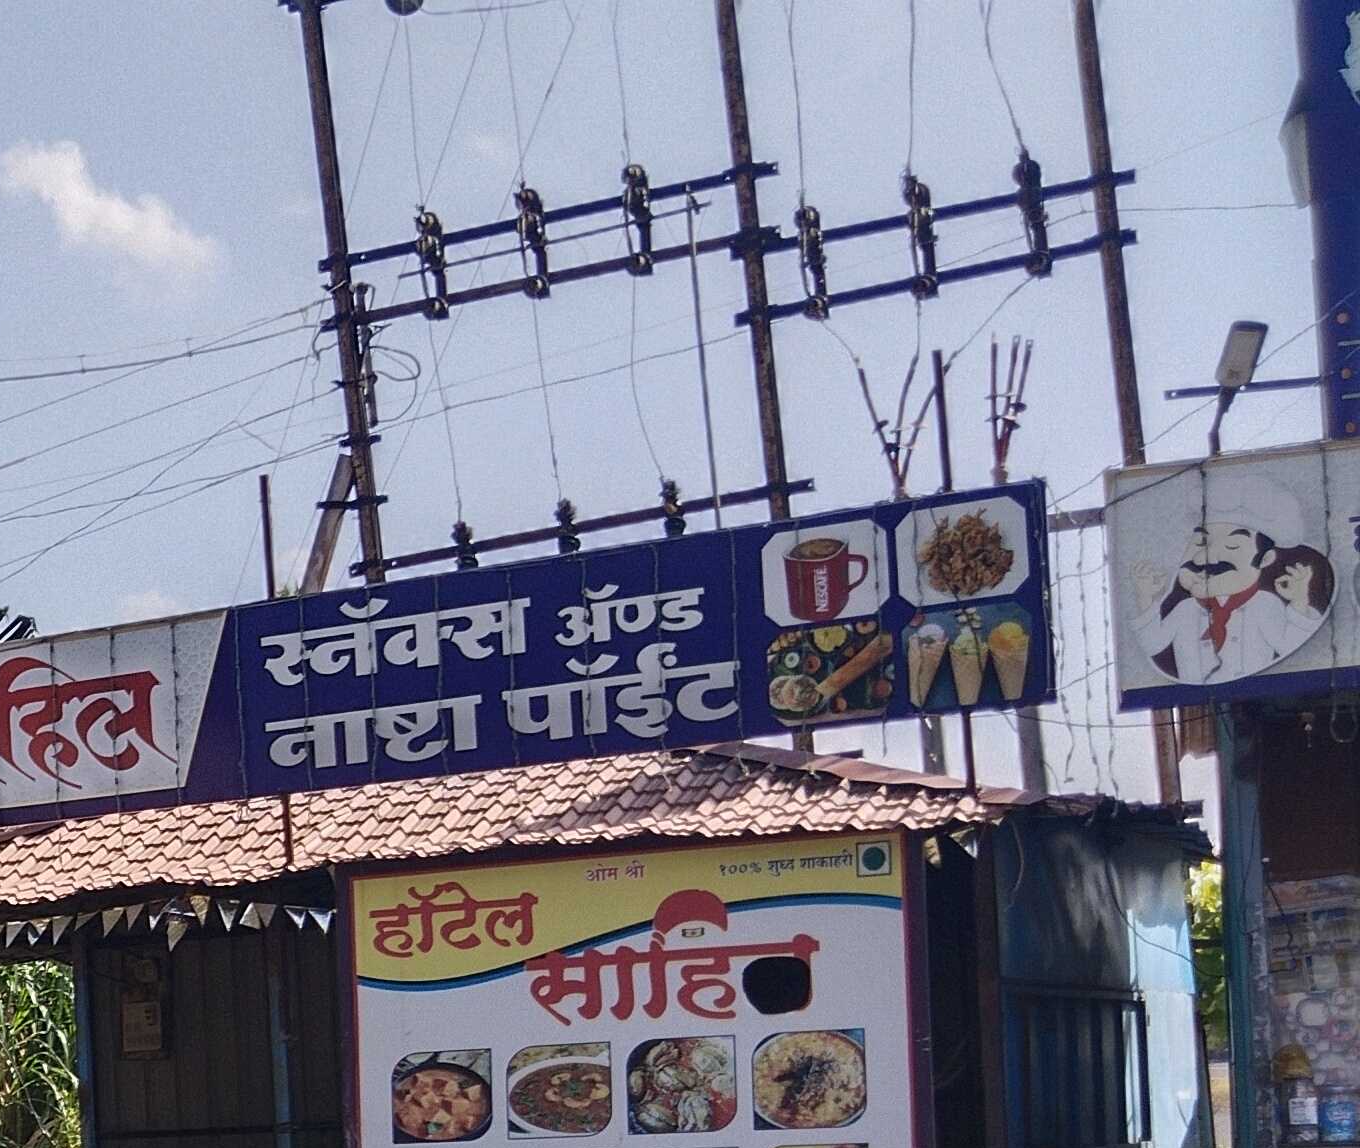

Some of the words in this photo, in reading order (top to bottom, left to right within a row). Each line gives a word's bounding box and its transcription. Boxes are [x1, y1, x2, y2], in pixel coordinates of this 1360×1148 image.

[259, 596, 531, 687] स्नॅक्स
[264, 692, 483, 770] नाष्टा
[502, 643, 741, 742] पॉईंट
[368, 881, 539, 959] हॉटेल
